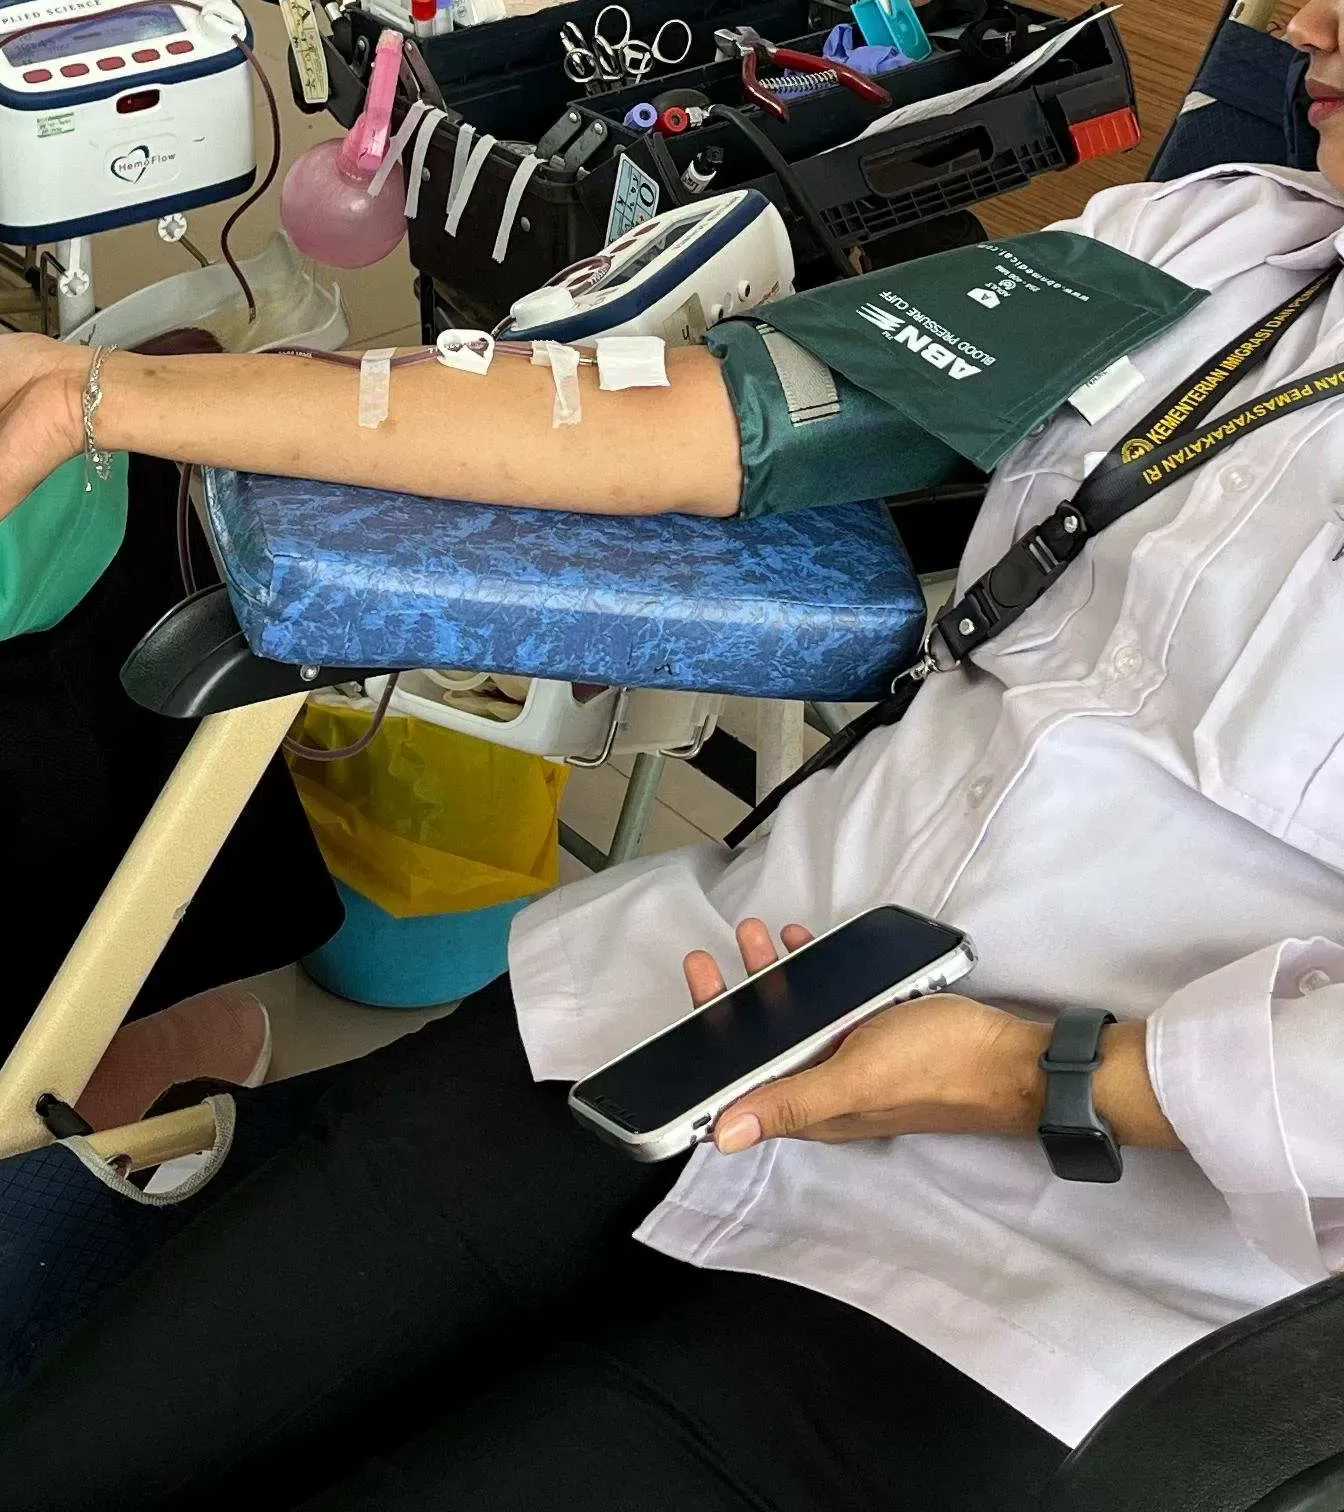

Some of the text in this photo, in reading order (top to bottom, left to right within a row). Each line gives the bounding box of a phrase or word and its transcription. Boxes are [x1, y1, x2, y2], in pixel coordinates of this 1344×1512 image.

[118, 152, 177, 174] HemoFlow
[878, 290, 997, 367] BLOOD PRESSURE CUFF
[1145, 368, 1230, 445] KEMENTERIAN
[1219, 328, 1274, 371] IMIGRASI
[1265, 308, 1296, 328] DAN
[1161, 383, 1314, 473] PEMASYARAKATAN
[1142, 464, 1163, 485] RI
